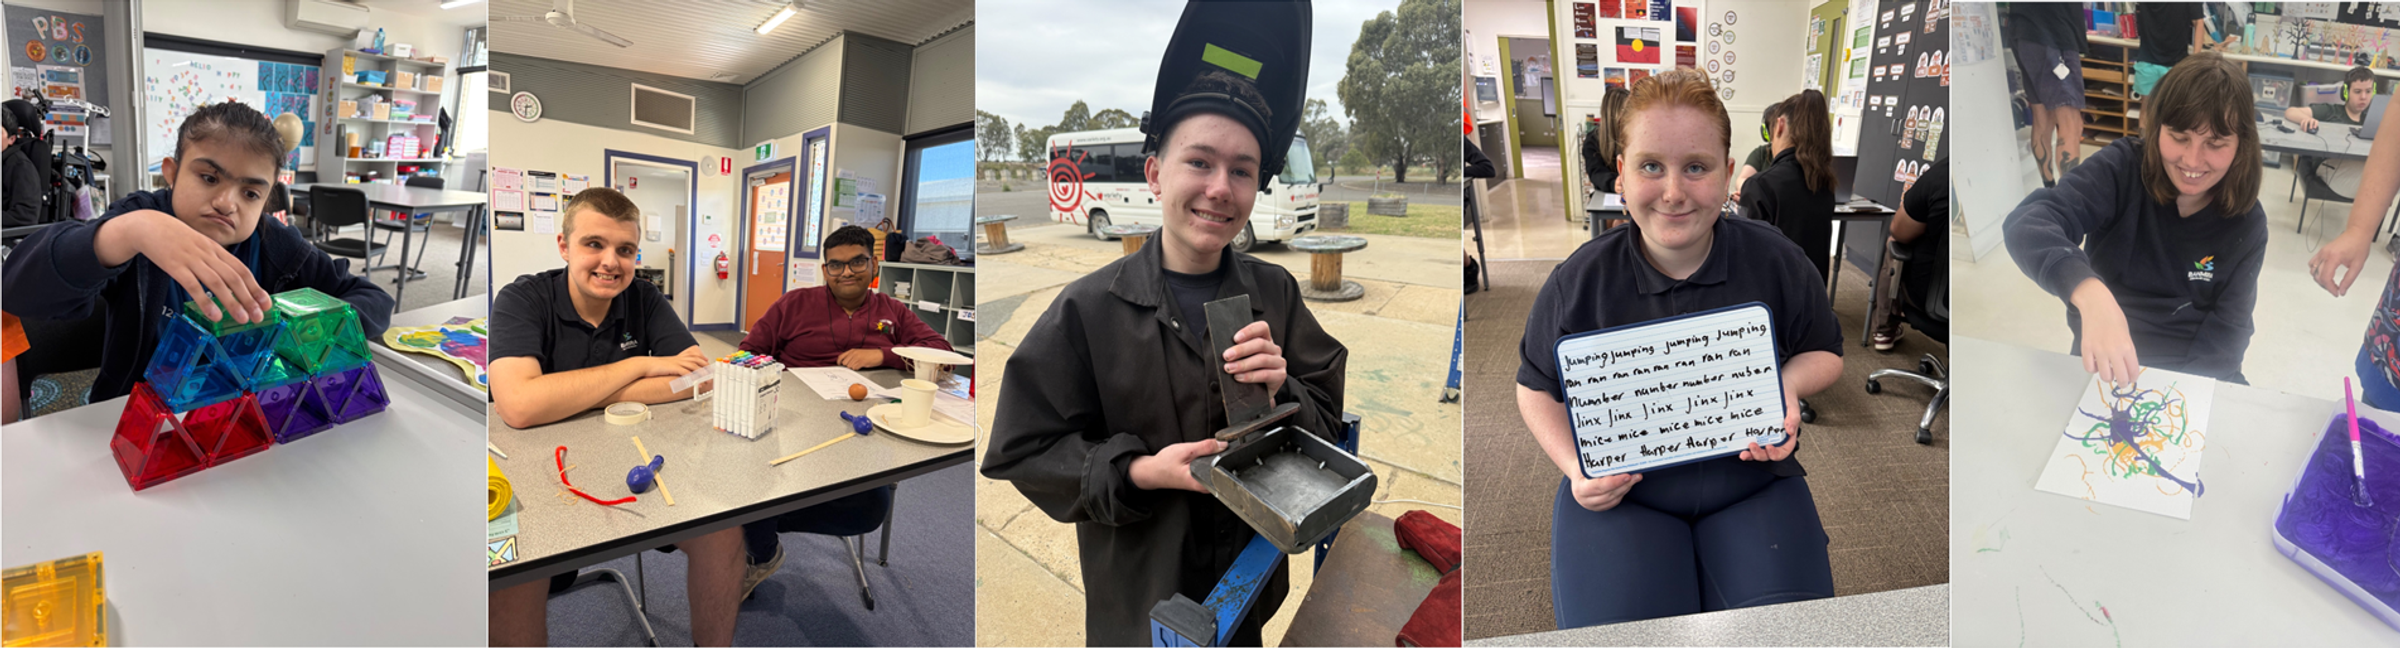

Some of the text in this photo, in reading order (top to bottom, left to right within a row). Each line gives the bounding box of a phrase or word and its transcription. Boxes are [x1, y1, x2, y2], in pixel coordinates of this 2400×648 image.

[31, 16, 85, 43] PBS
[1565, 348, 1751, 389] ran ran ran ran ran ran ran ran
[1683, 374, 1724, 387] number
[1580, 407, 1764, 447] mice mice mice mice mice
[1583, 453, 1626, 468] Harper
[1640, 443, 1681, 457] Harper
[1686, 433, 1735, 449] Harper
